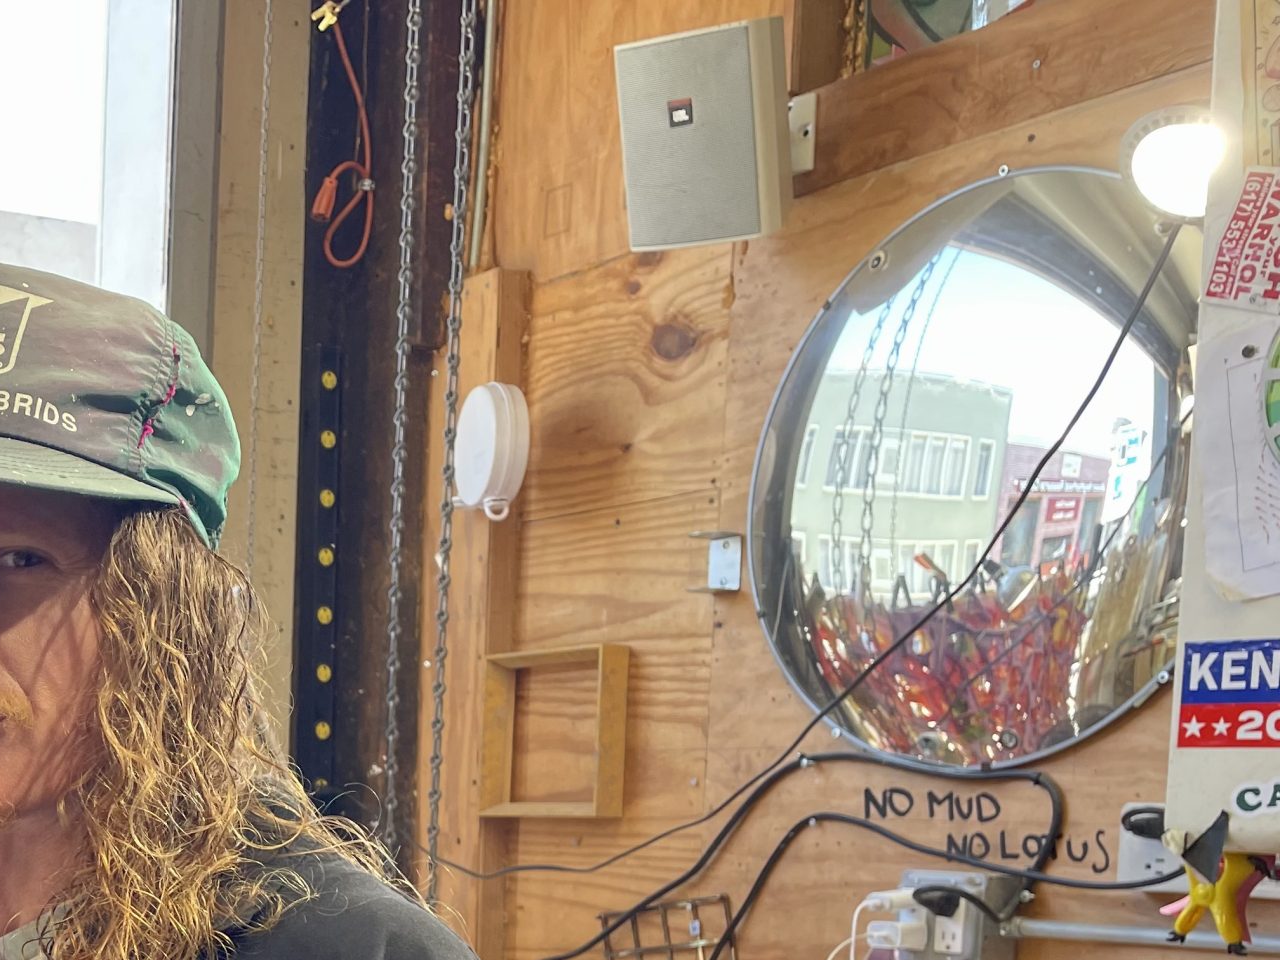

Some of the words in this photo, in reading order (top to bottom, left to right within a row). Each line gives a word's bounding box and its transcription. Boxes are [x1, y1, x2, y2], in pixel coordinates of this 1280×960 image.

[1237, 176, 1263, 217] (617)
[1210, 220, 1245, 293] 553-1103
[865, 788, 913, 819] NO
[928, 791, 1001, 822] MUD
[947, 832, 990, 860] NO
